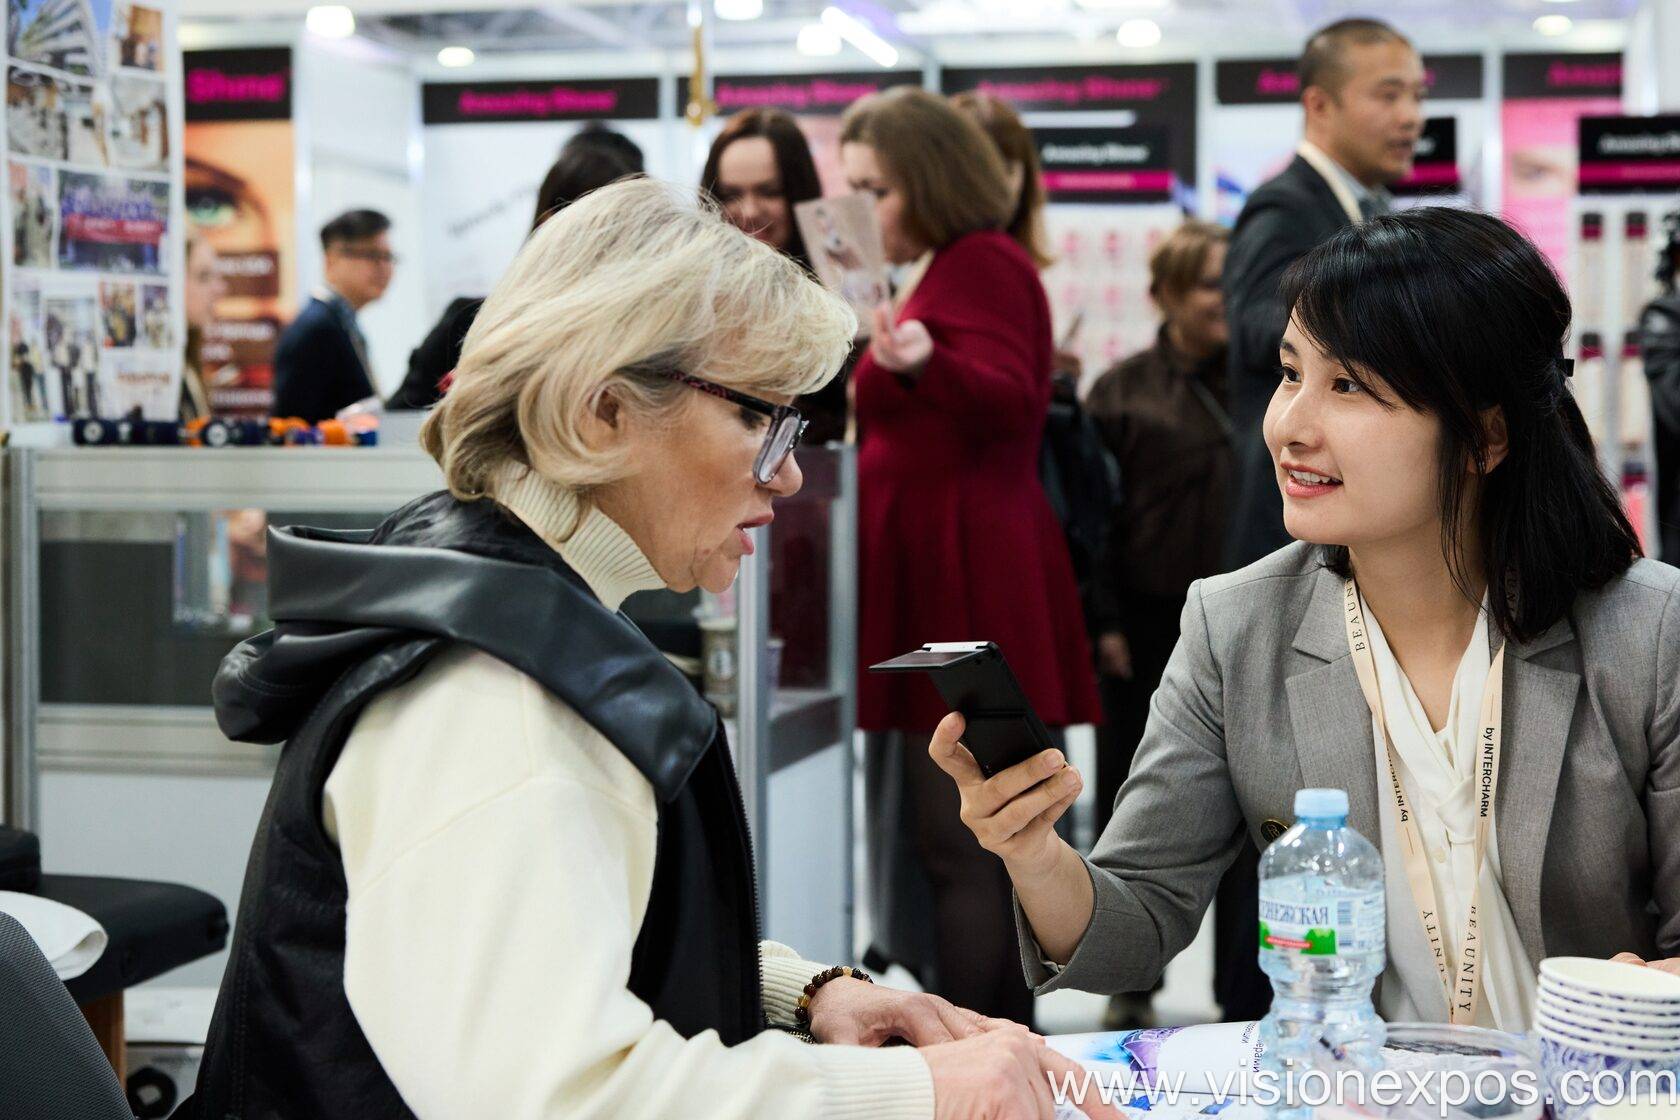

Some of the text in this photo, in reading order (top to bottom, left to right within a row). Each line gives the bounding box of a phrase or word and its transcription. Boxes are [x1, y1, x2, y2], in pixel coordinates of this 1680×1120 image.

[1480, 727, 1495, 818] by INTERCHARM
[1400, 808, 1409, 822] by
